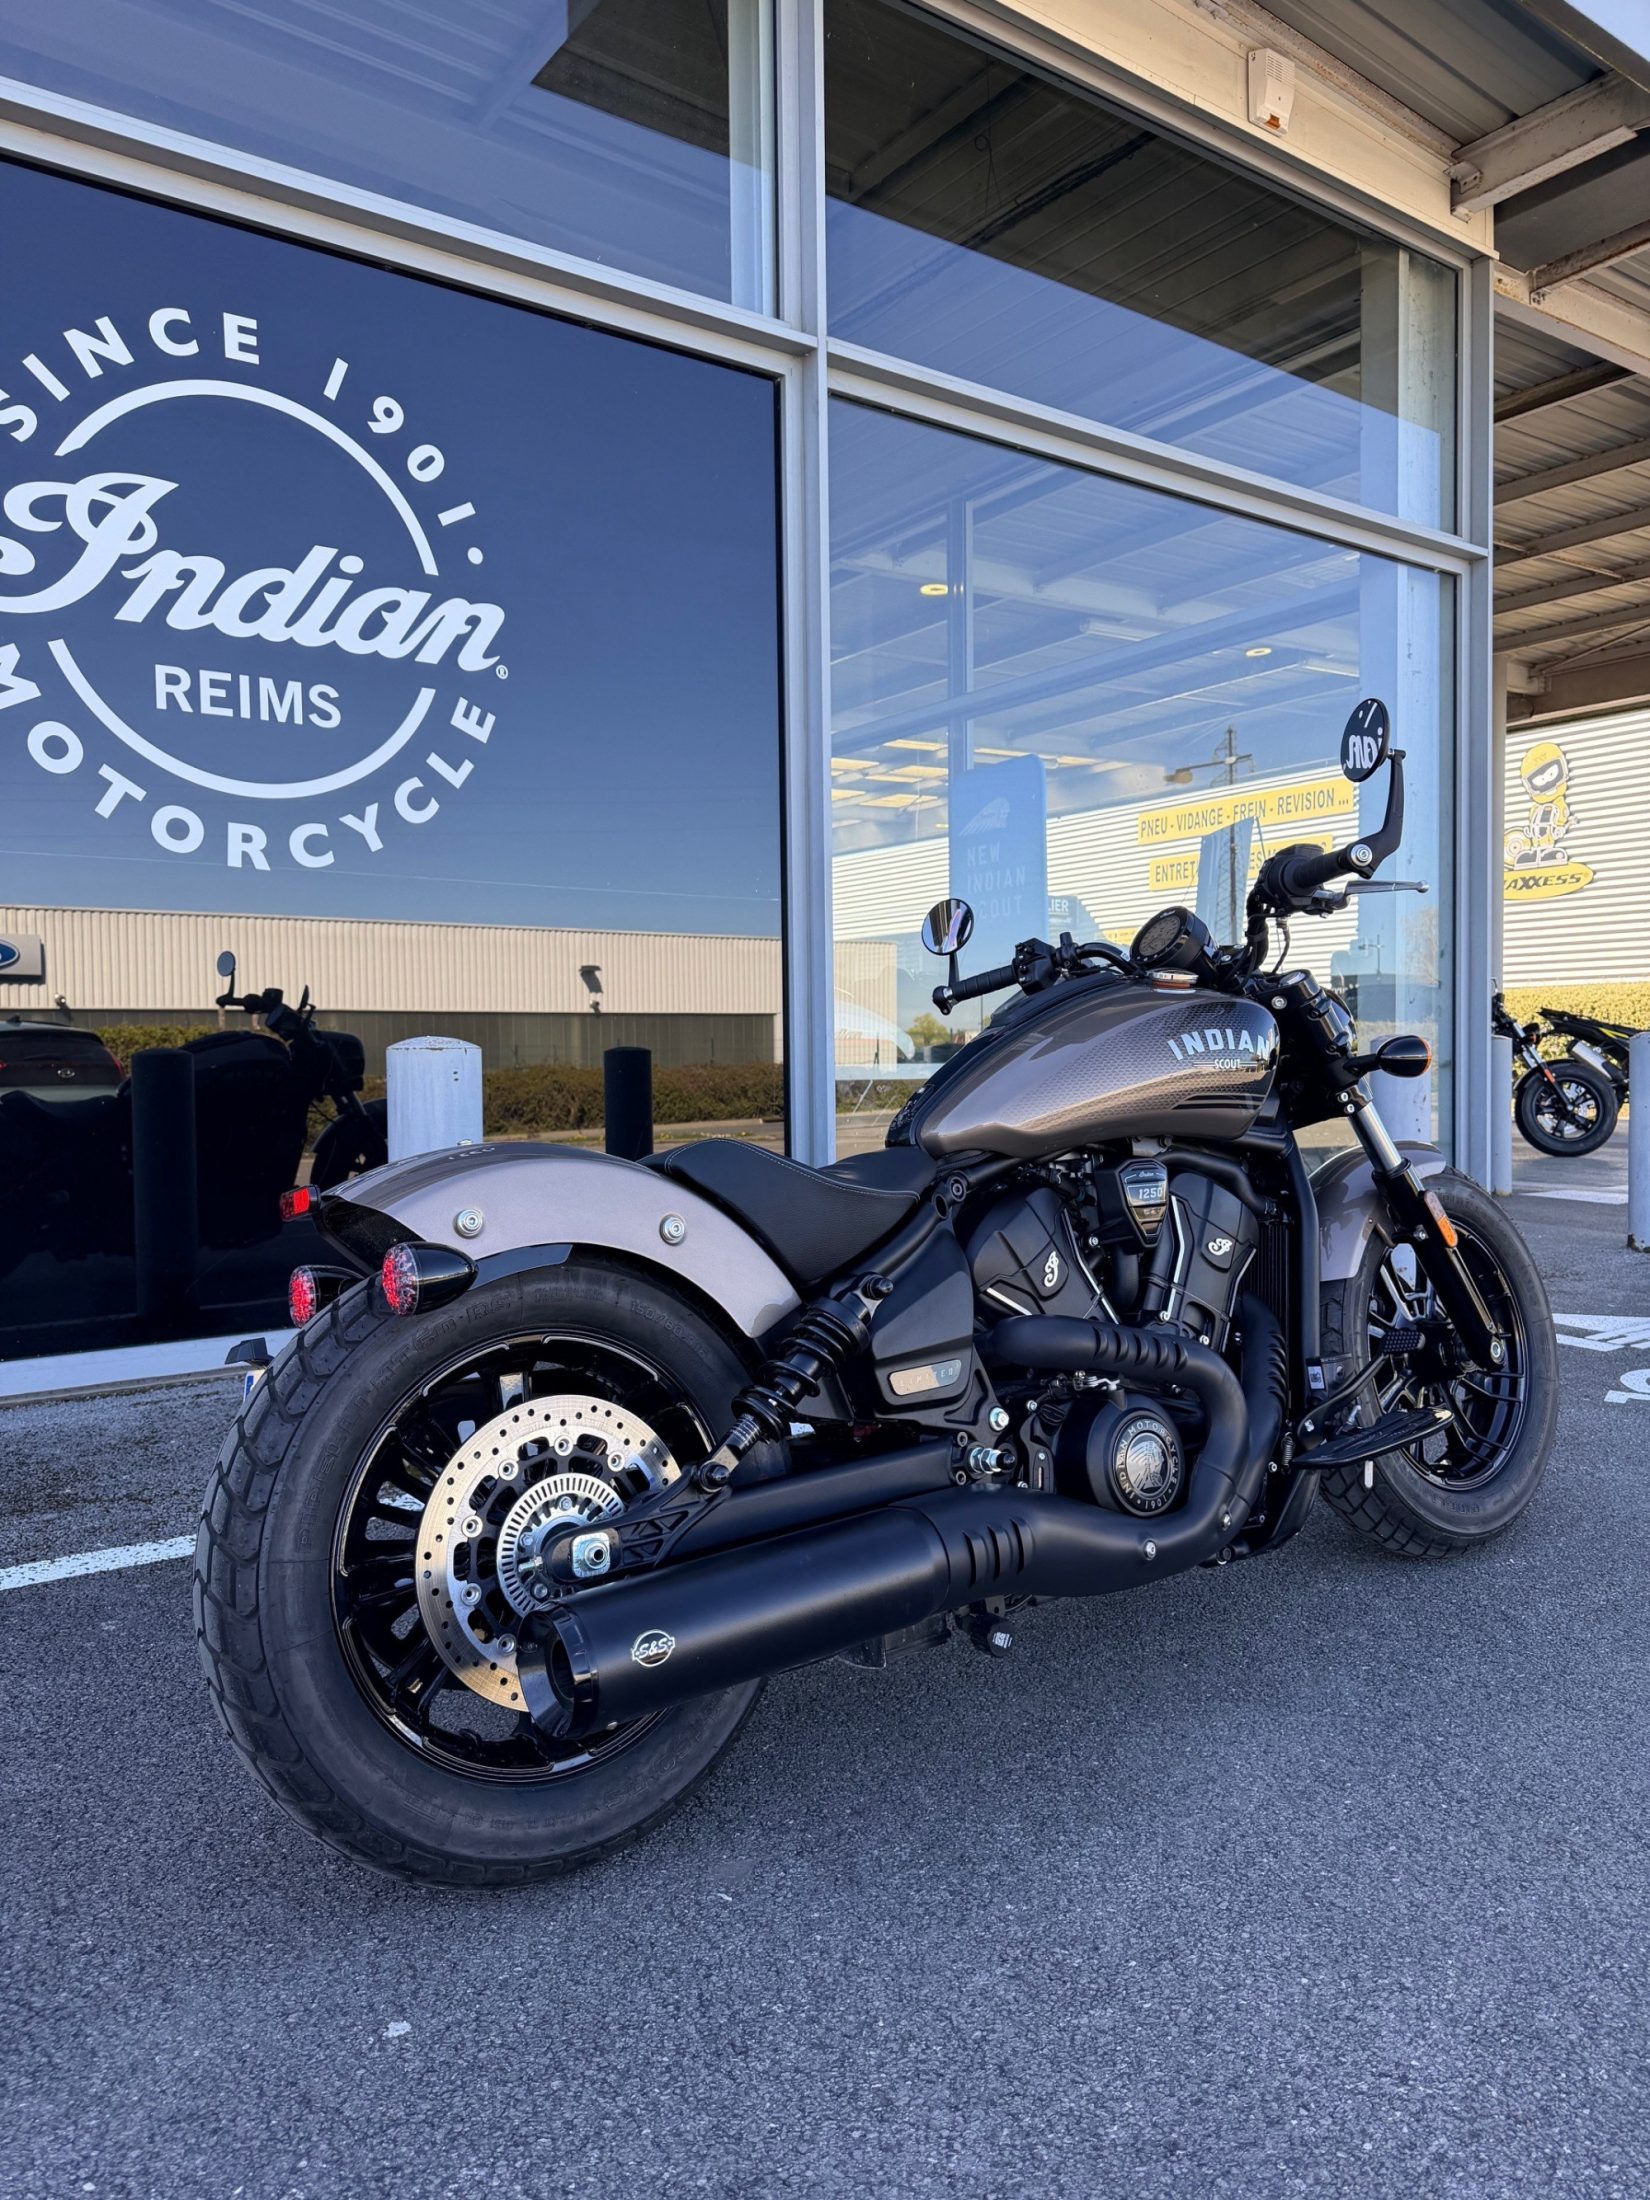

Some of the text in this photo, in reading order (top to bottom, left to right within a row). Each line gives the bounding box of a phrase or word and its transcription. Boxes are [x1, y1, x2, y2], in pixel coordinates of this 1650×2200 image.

[0, 472, 506, 672] Indian
[154, 664, 342, 728] REIMS
[1141, 817, 1168, 838] PNEU
[1176, 807, 1223, 832] VIDANGE
[1233, 800, 1267, 820] FREIN
[1277, 788, 1335, 815] REVISION
[967, 841, 1001, 867] NEW
[966, 865, 1026, 895] INDIAN
[1155, 860, 1197, 883] ENTRET
[1504, 872, 1584, 891] AXXESS
[978, 895, 1023, 920] COUT
[1167, 1027, 1271, 1062] INDIAN
[1214, 1058, 1241, 1070] SCOUT
[1138, 1187, 1163, 1199] 1250
[1118, 1420, 1180, 1500] INDIAN MOTORCYCLE
[637, 1637, 668, 1660] S&S
